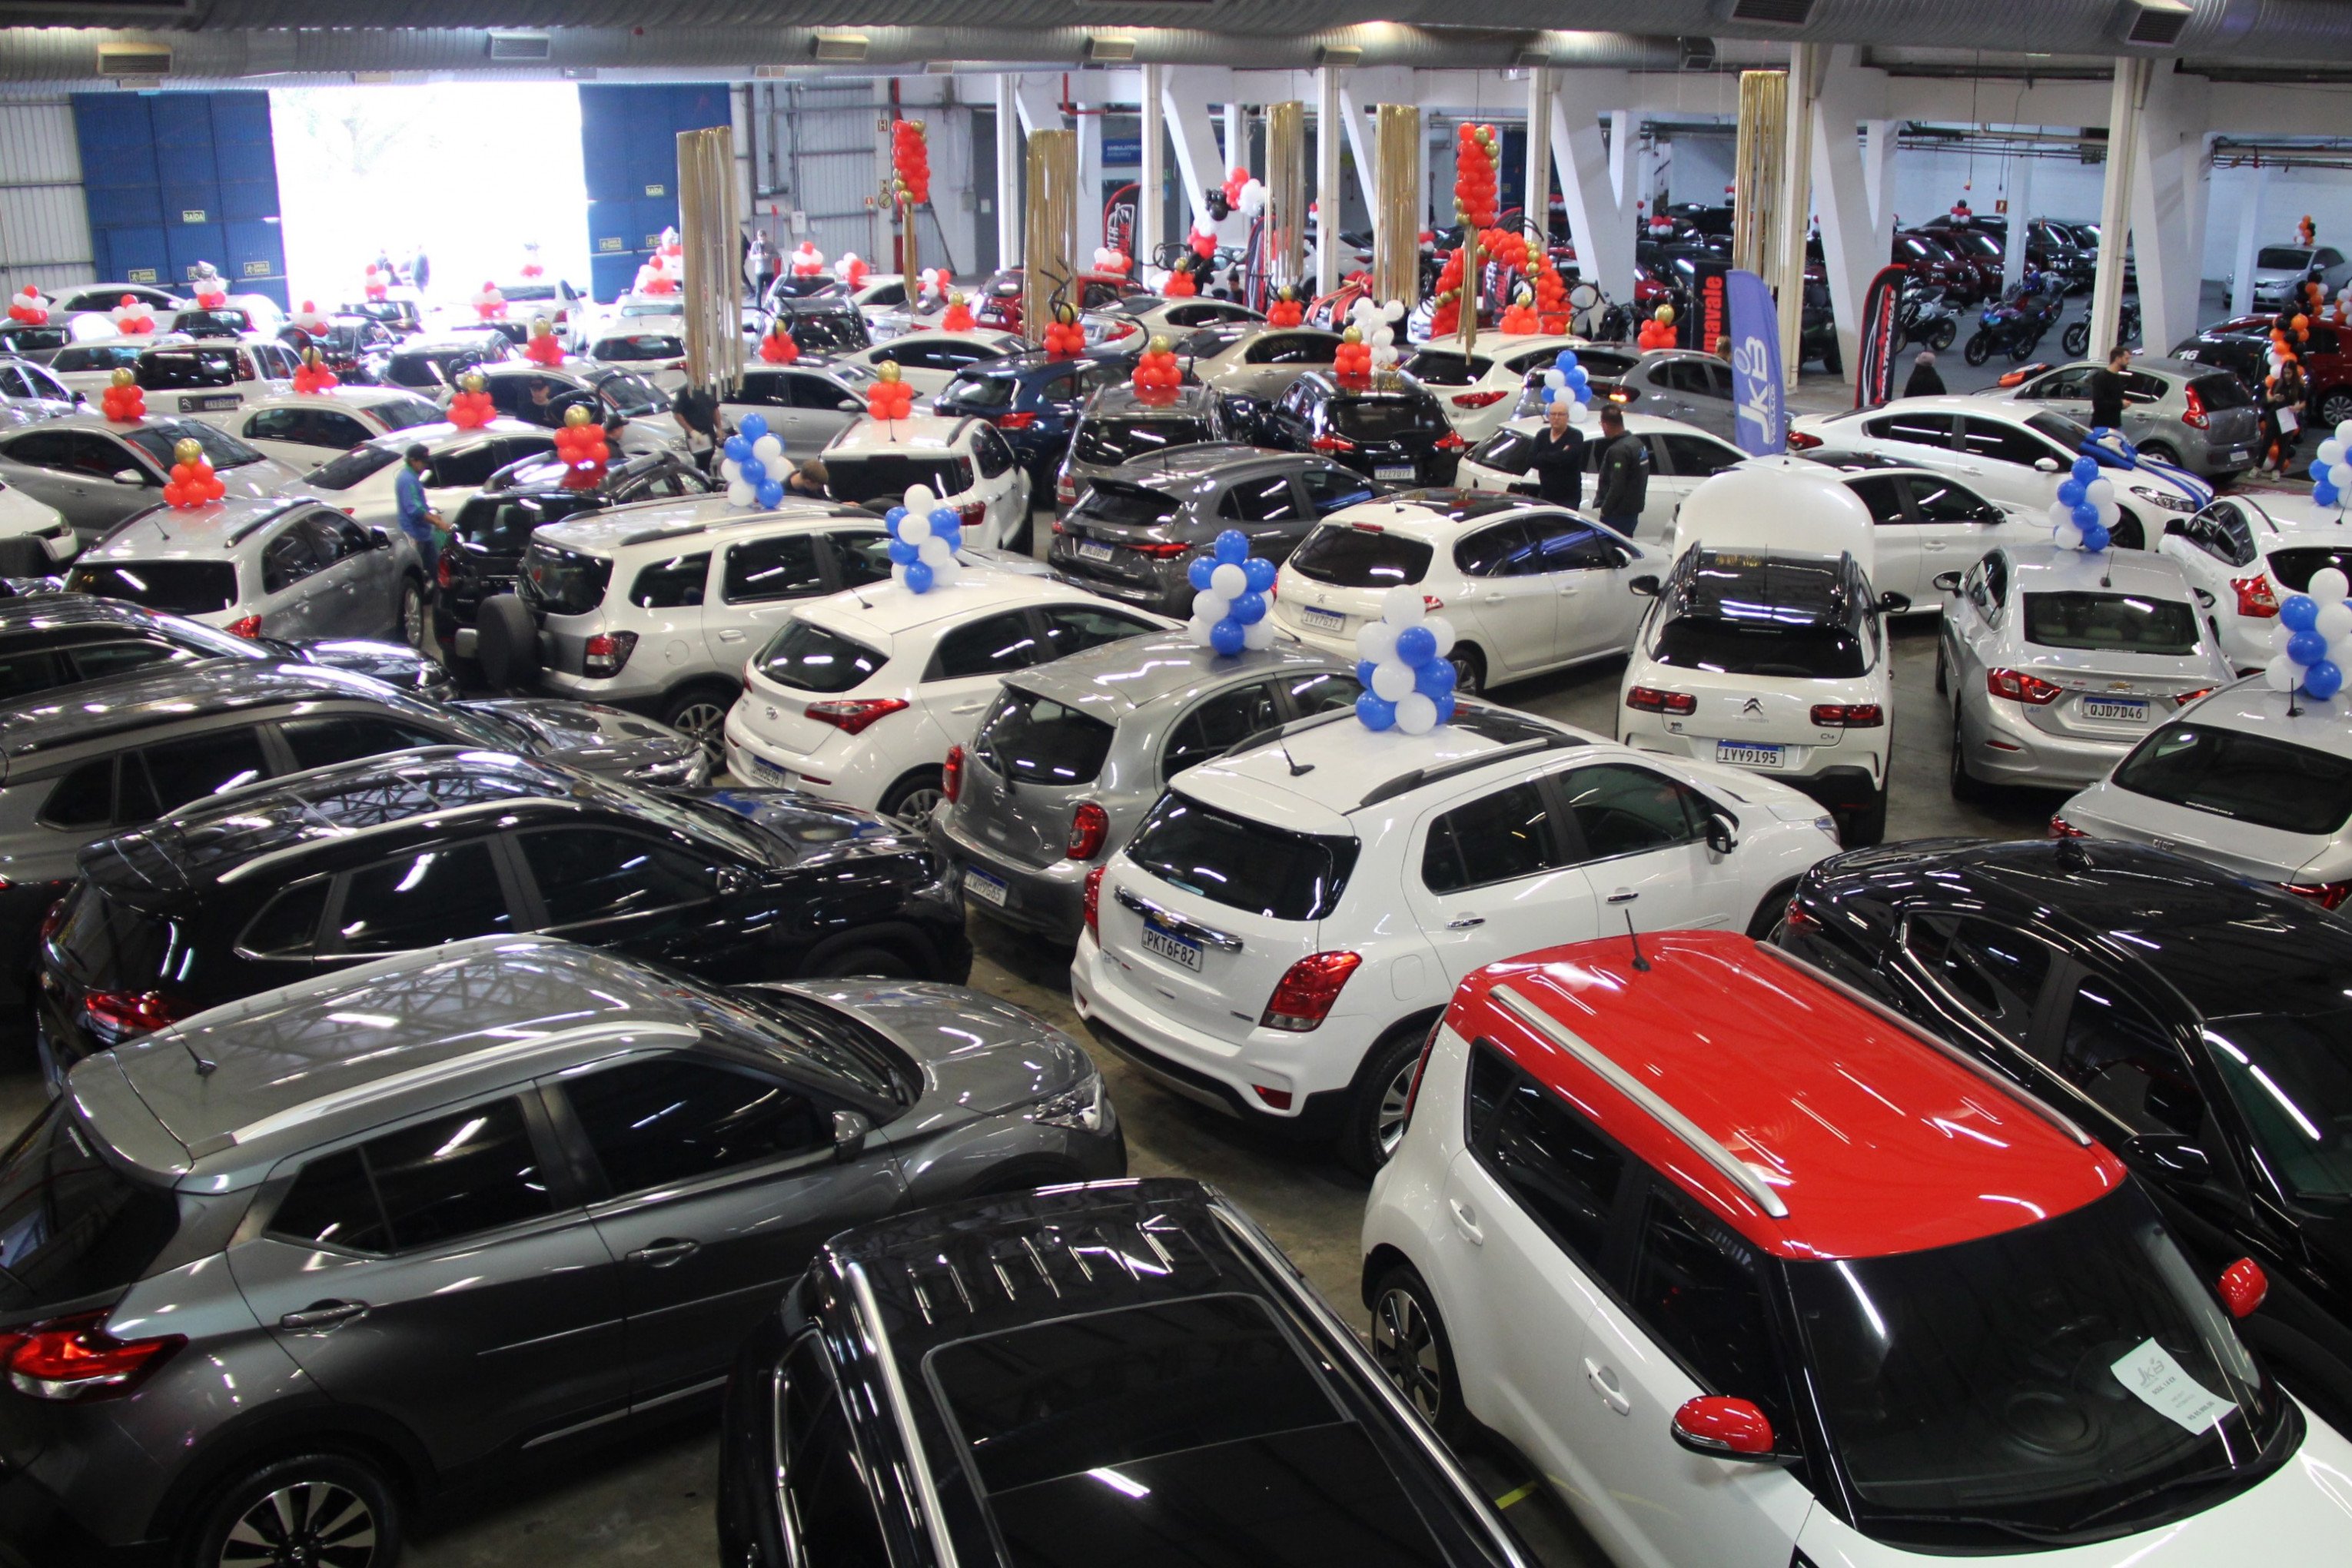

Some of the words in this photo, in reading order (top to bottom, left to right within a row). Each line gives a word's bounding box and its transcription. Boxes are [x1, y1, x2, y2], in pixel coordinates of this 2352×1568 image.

[184, 213, 204, 221] SAÍDA
[2179, 349, 2199, 360] 16
[1739, 336, 1769, 444] JKB
[2090, 704, 2142, 719] QJD7D46
[1722, 749, 1777, 764] IYY9I95
[1147, 931, 1194, 966] PKT6F82
